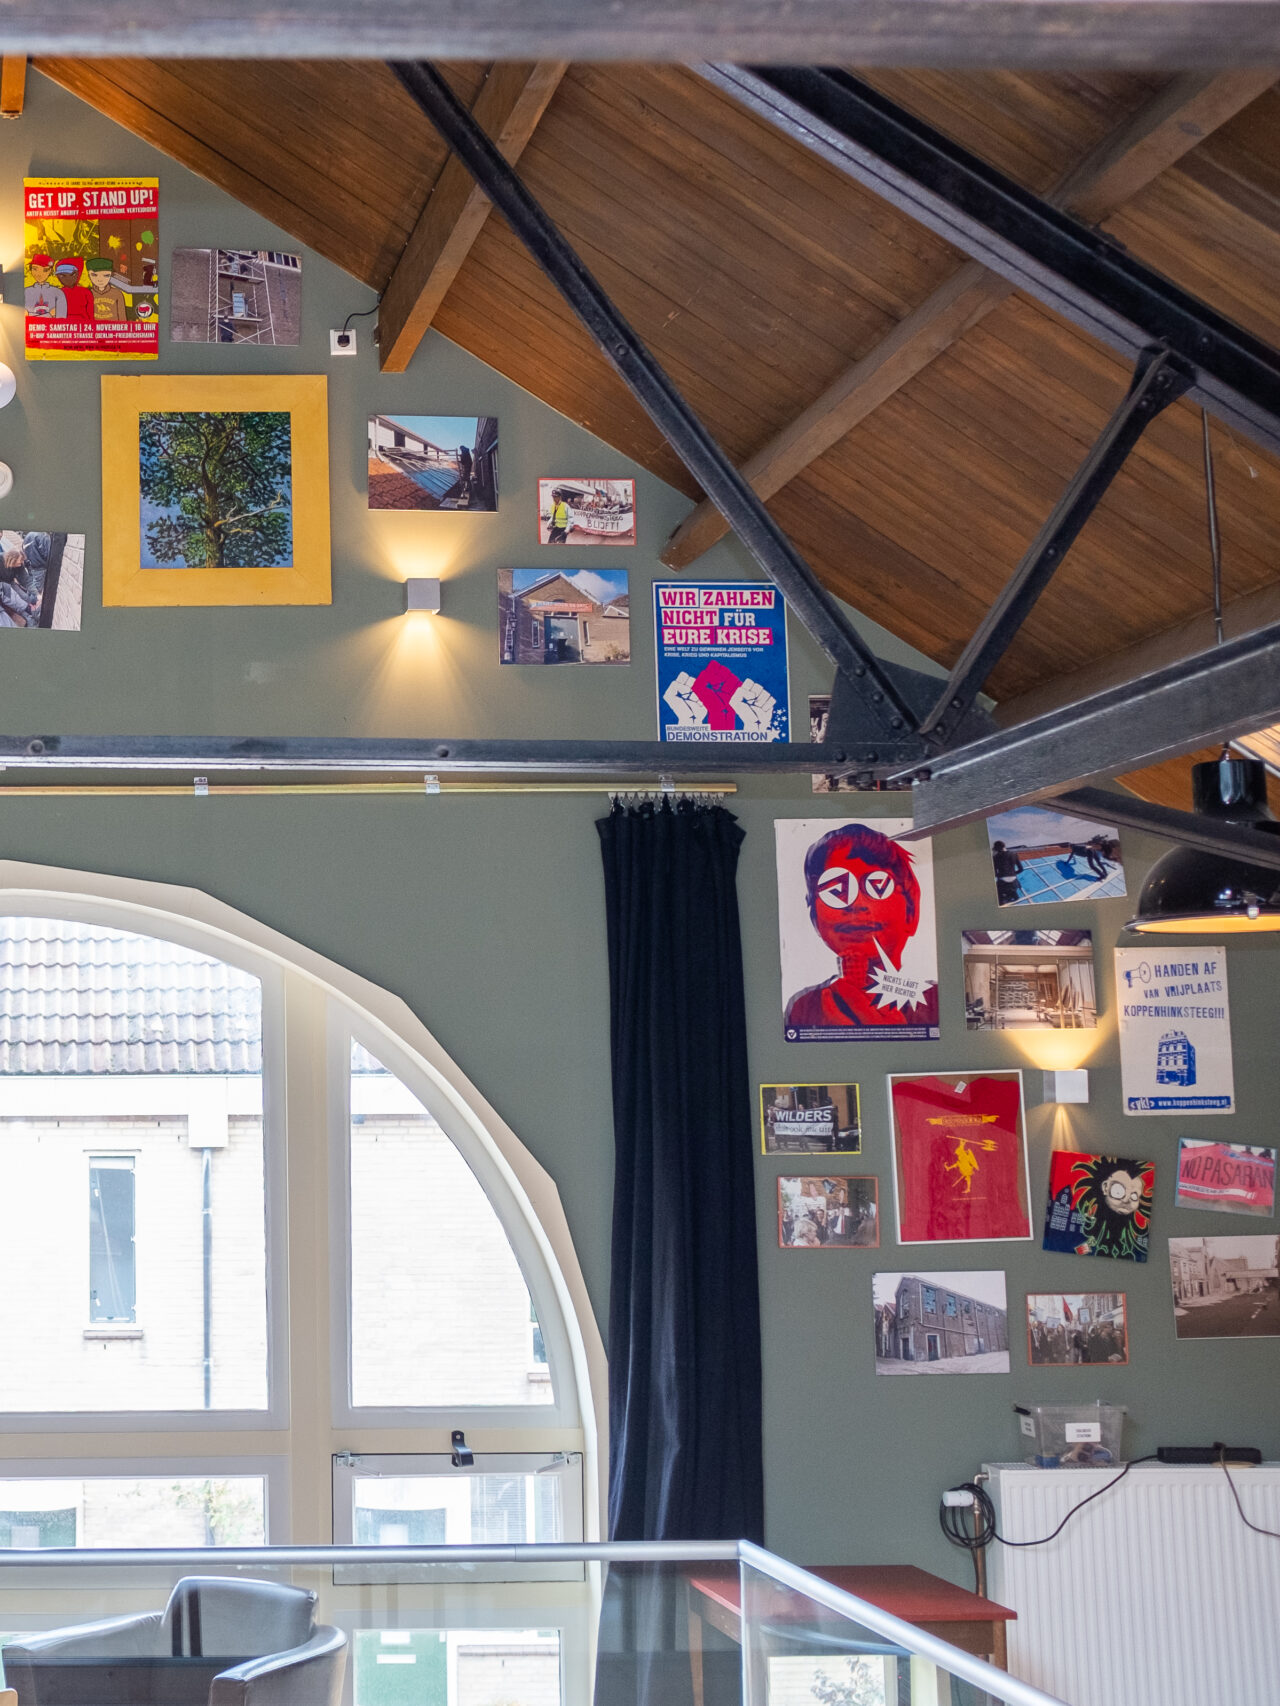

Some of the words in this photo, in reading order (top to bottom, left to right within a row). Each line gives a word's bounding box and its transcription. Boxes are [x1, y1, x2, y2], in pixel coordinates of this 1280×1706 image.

[28, 193, 54, 208] GET
[83, 190, 126, 207] STAND
[130, 189, 154, 204] UP!
[661, 591, 696, 606] WIR
[703, 591, 772, 606] ZAHLEN
[663, 610, 717, 625] NICHT
[724, 608, 755, 626] FÜR
[663, 629, 711, 644] EURE
[716, 629, 770, 644] KRISE
[667, 732, 768, 741] DEMONSTRATION
[1155, 962, 1199, 977] HANDEN
[1204, 962, 1216, 975] AF
[883, 974, 901, 985] NICHTS
[882, 984, 893, 992] HIER
[1144, 989, 1159, 998] VAN
[1165, 980, 1222, 997] VRIJPLAATS
[1124, 1005, 1224, 1019] KOPPENHINKSTEEG!!!
[775, 1110, 832, 1121] WILDERS
[1182, 1156, 1201, 1179] NO
